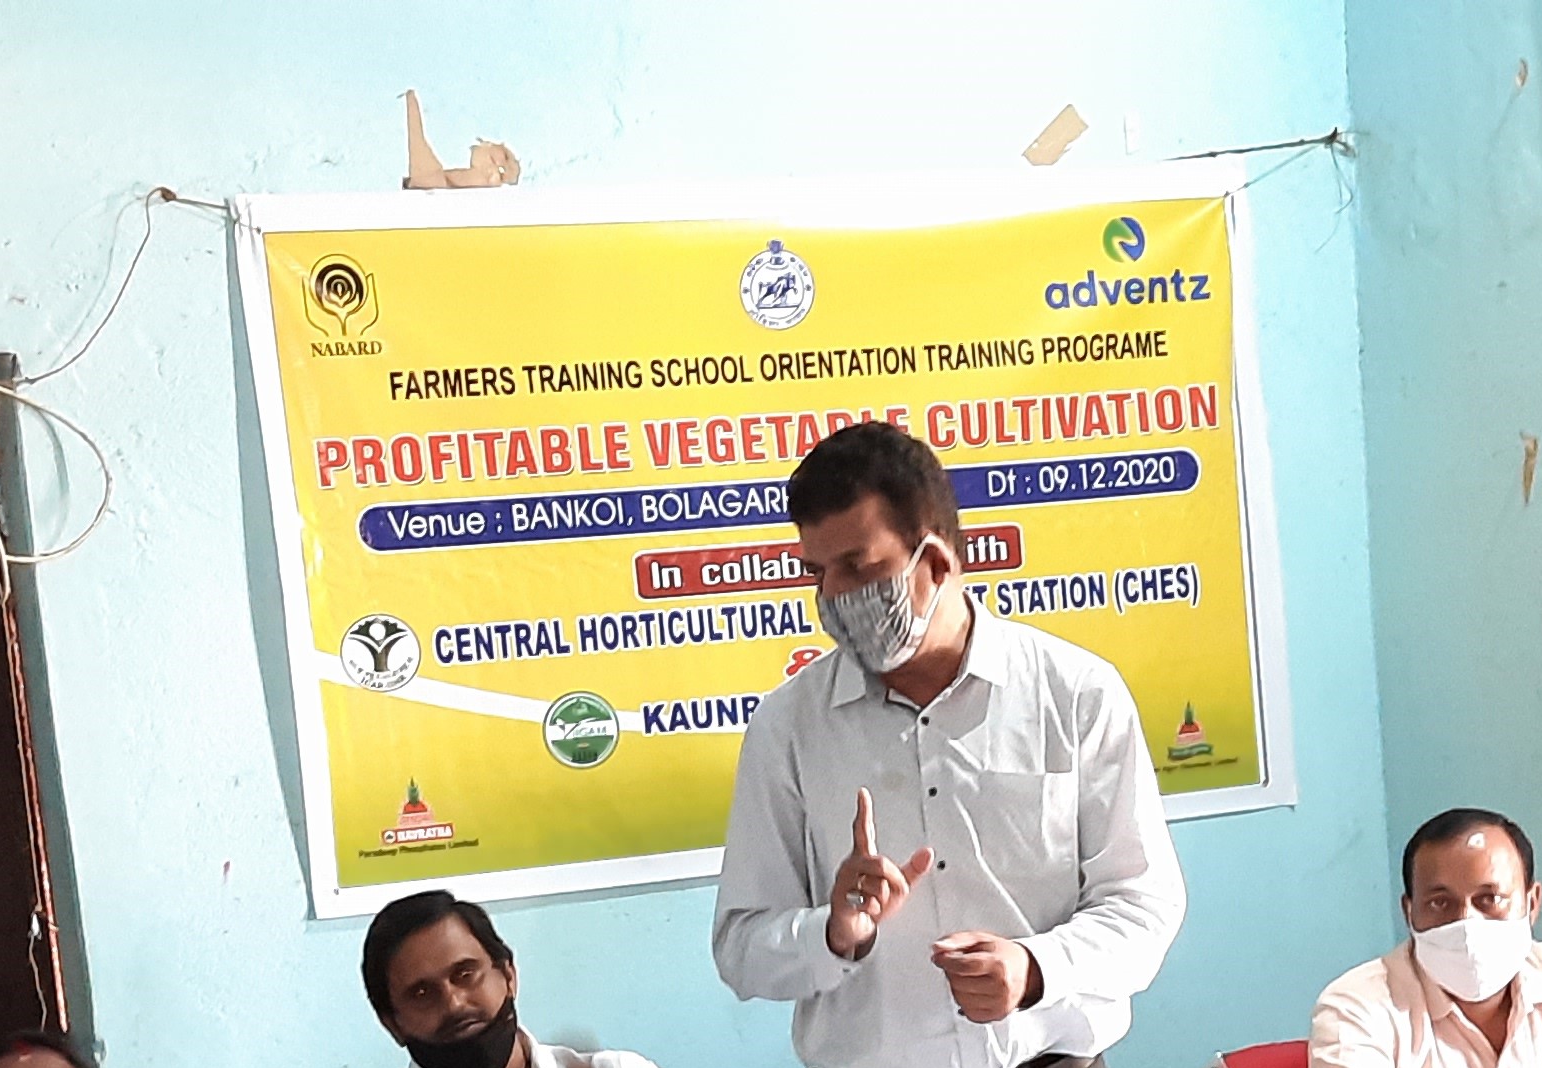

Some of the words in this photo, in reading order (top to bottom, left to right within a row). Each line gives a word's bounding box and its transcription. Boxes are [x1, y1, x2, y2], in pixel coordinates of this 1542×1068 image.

[1045, 269, 1211, 309] adventz
[311, 340, 383, 357] NABARD
[390, 366, 516, 400] FARMERS
[522, 360, 643, 394] TRAINING
[650, 355, 754, 388] SCHOOL
[760, 346, 916, 381] ORIENTATION
[923, 338, 1035, 372] TRAINING
[1041, 330, 1169, 364] PROGRAME
[316, 424, 631, 487] PROFITABLE
[926, 385, 1218, 448] CULTIVATION
[387, 509, 486, 540] Venue
[511, 497, 634, 532] BANKOI,
[988, 468, 1017, 498] Dt
[1039, 455, 1176, 493] 09.12.2020
[650, 561, 682, 590] In
[701, 551, 813, 586] collab
[966, 535, 1008, 564] ith
[435, 620, 571, 664] CENTRAL
[579, 601, 812, 653] HORTICULTURAL
[996, 574, 1106, 616] STATION
[1114, 565, 1200, 614] (CHES)
